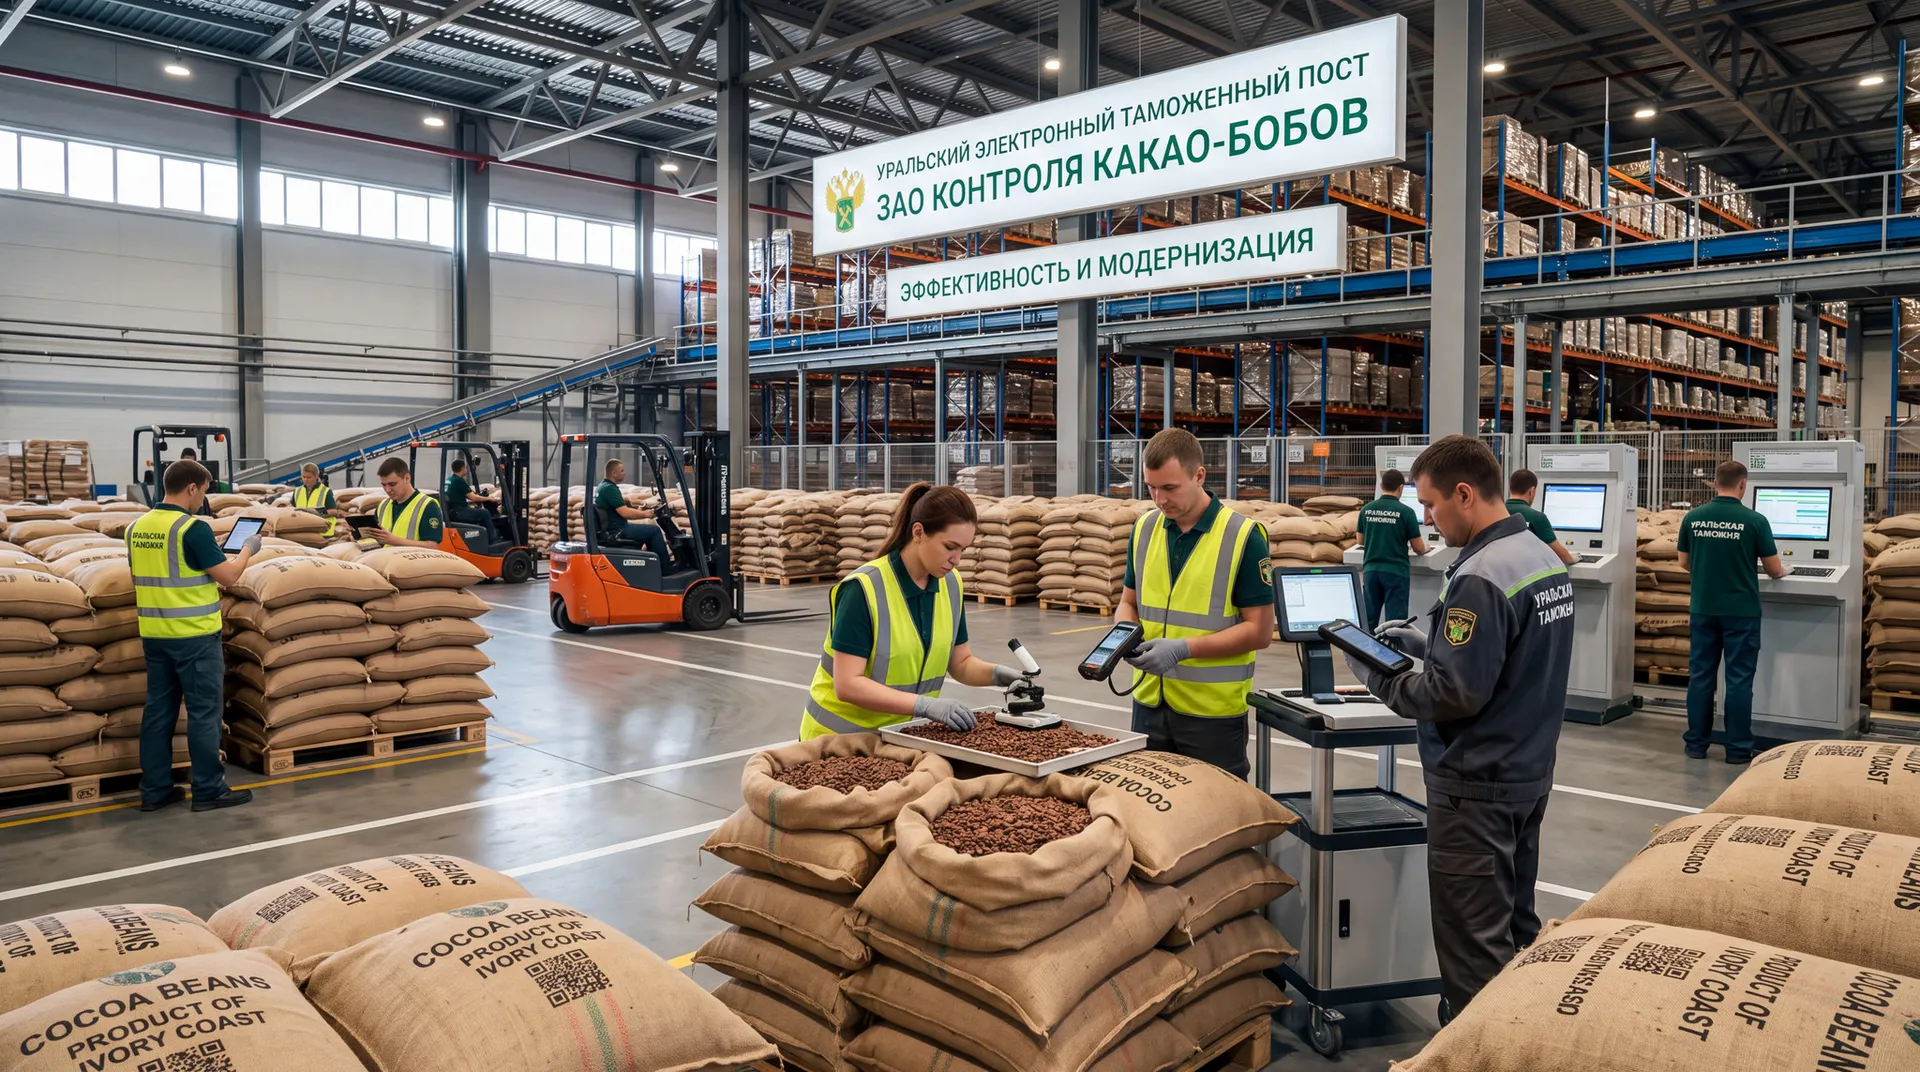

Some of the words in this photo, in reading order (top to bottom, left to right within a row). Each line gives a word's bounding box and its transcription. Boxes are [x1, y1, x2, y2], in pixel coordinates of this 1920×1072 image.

[877, 140, 970, 181] УРАЛЬСКИЙ
[975, 106, 1115, 158] ЭЛЕКТРОННЫЙ
[1120, 65, 1290, 127] ТАМОЖЕННЫЙ
[1299, 52, 1370, 89] ПОСТ
[877, 187, 924, 221] ЗАО
[933, 153, 1083, 211] КОНТРОЛЯ
[1094, 97, 1369, 181] КАКАО-БОБОВ
[900, 261, 1070, 301] ЭФФЕКТИВНОСТЬ
[1077, 258, 1091, 280] И
[1100, 227, 1314, 278] МОДЕРНИЗАЦИЯ
[1691, 520, 1744, 531] УРАЛЬСКАЯ
[1693, 530, 1740, 540] ТАМОЖНЯ
[1117, 777, 1172, 812] COCOA
[364, 882, 388, 892] OF
[1782, 846, 1821, 886] COAST
[1828, 861, 1856, 878] OF
[327, 883, 366, 905] COAST
[51, 941, 79, 955] OF
[412, 920, 510, 968] COCOA
[505, 908, 588, 925] BEANS
[459, 924, 555, 967] PRODUCT
[558, 920, 583, 930] OF
[475, 943, 538, 979] IVORY
[541, 930, 606, 949] COAST
[1709, 946, 1757, 980] IVORY
[1745, 954, 1802, 1003] PRODUCT
[20, 992, 154, 1056] COCOA
[157, 975, 271, 1000] BEANS
[1678, 978, 1730, 1042] COAST
[1735, 1001, 1770, 1030] OF
[1839, 971, 1901, 1017] COCOA
[67, 1001, 203, 1060] PRODUCT
[211, 996, 246, 1010] OF
[79, 1031, 166, 1072] IVORY
[176, 1011, 266, 1039] COAST
[1815, 1012, 1880, 1072] BEAN
